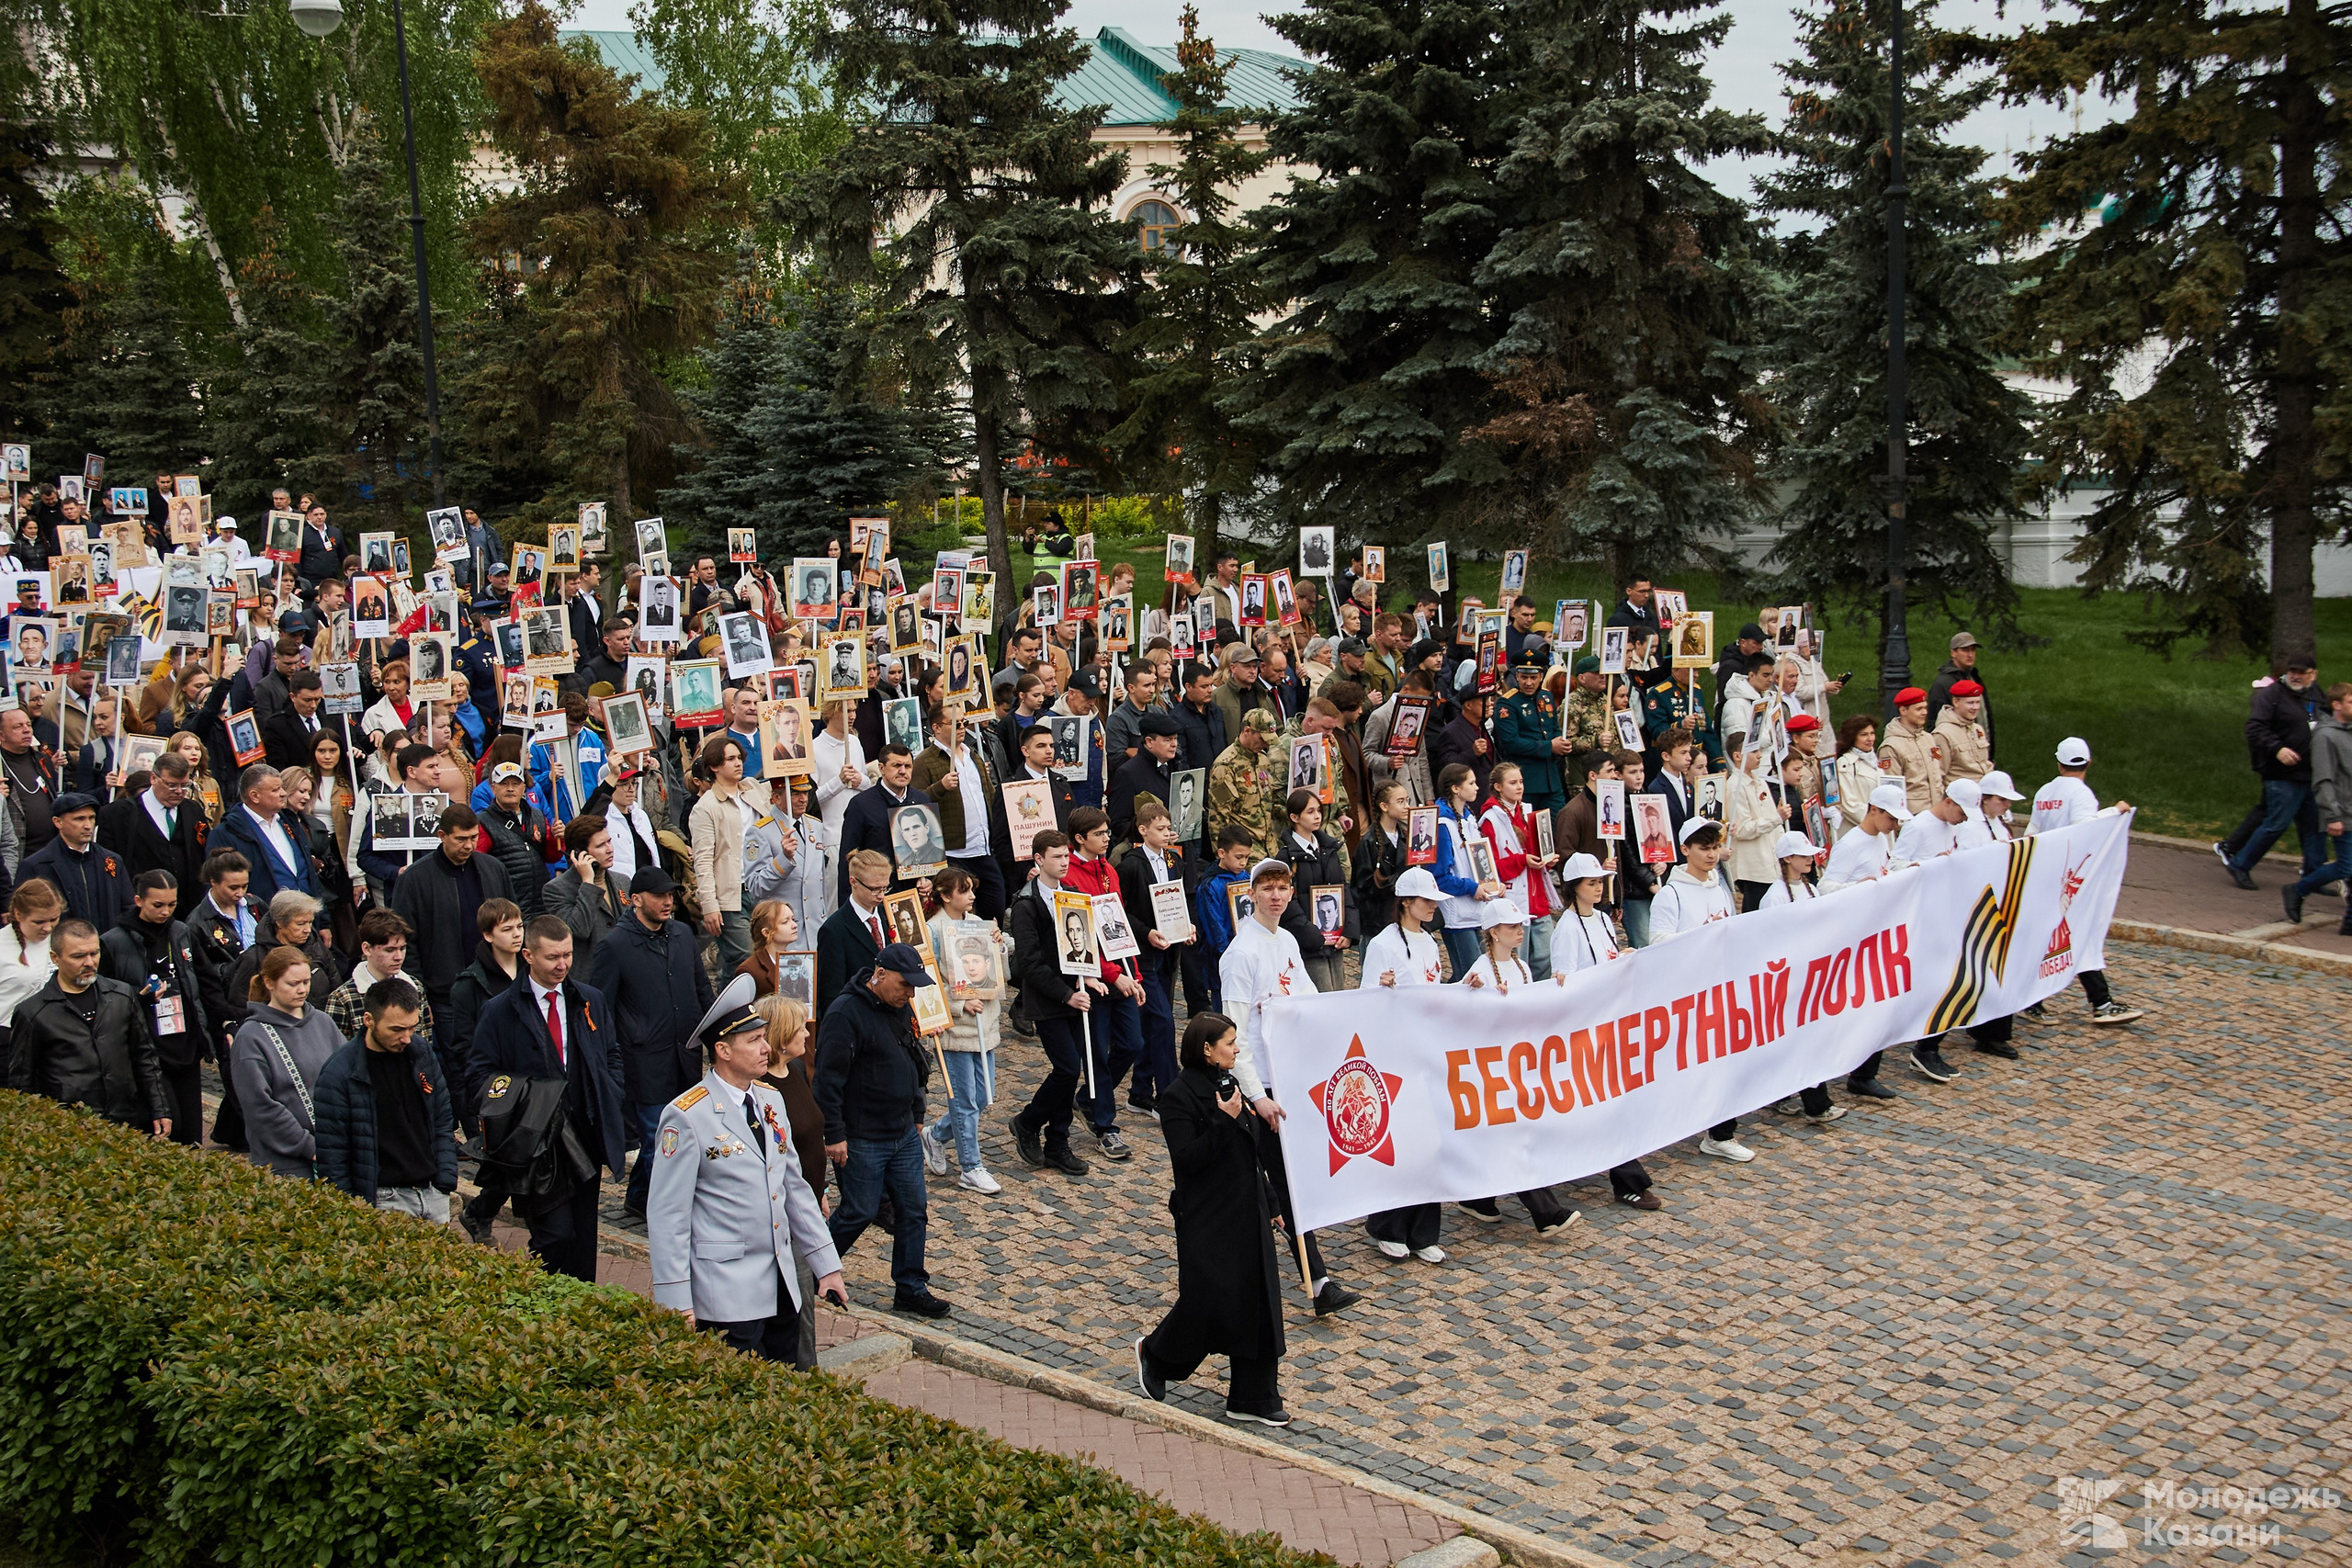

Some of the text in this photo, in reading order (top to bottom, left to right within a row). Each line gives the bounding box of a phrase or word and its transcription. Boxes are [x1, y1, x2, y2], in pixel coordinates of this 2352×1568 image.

[1013, 819, 1054, 831] ПАШУНИН
[2039, 951, 2074, 980] ПОБЕДА!
[1445, 923, 1912, 1131] БЕССМЕРТНЫЙ ПОЛК
[1328, 1080, 1337, 1094] ЛЕТ
[1336, 1061, 1366, 1079] ВЕЛИКОЙ
[1366, 1066, 1386, 1102] ПОБЕДЫ
[1342, 1143, 1355, 1152] 1941
[1363, 1137, 1377, 1149] 1945
